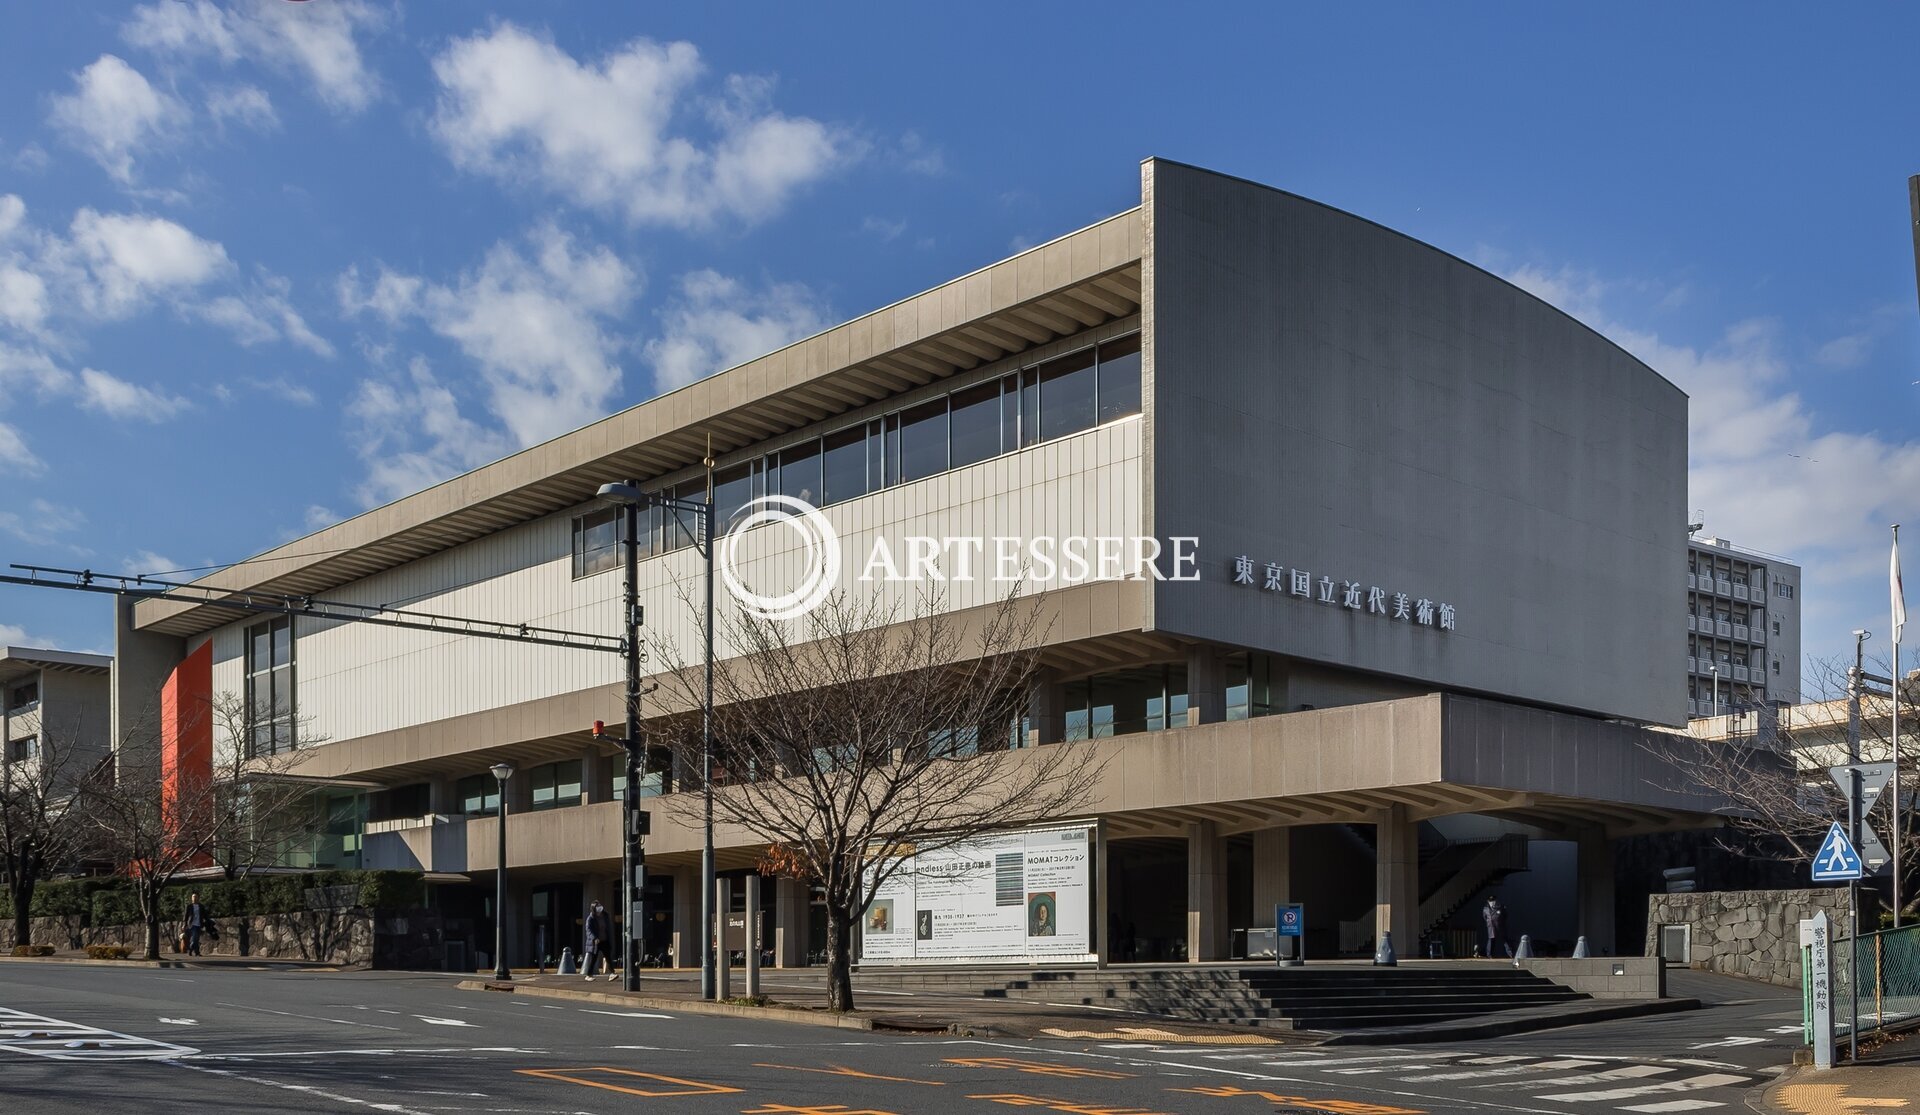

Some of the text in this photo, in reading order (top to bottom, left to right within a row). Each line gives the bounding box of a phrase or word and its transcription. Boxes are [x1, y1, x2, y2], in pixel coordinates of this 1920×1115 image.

[1233, 555, 1456, 631] 東京国立近代美術館
[916, 864, 943, 873] endless
[1027, 854, 1085, 865] MOMATコレクション
[1814, 927, 1827, 1010] 警視庁第一機動隊
